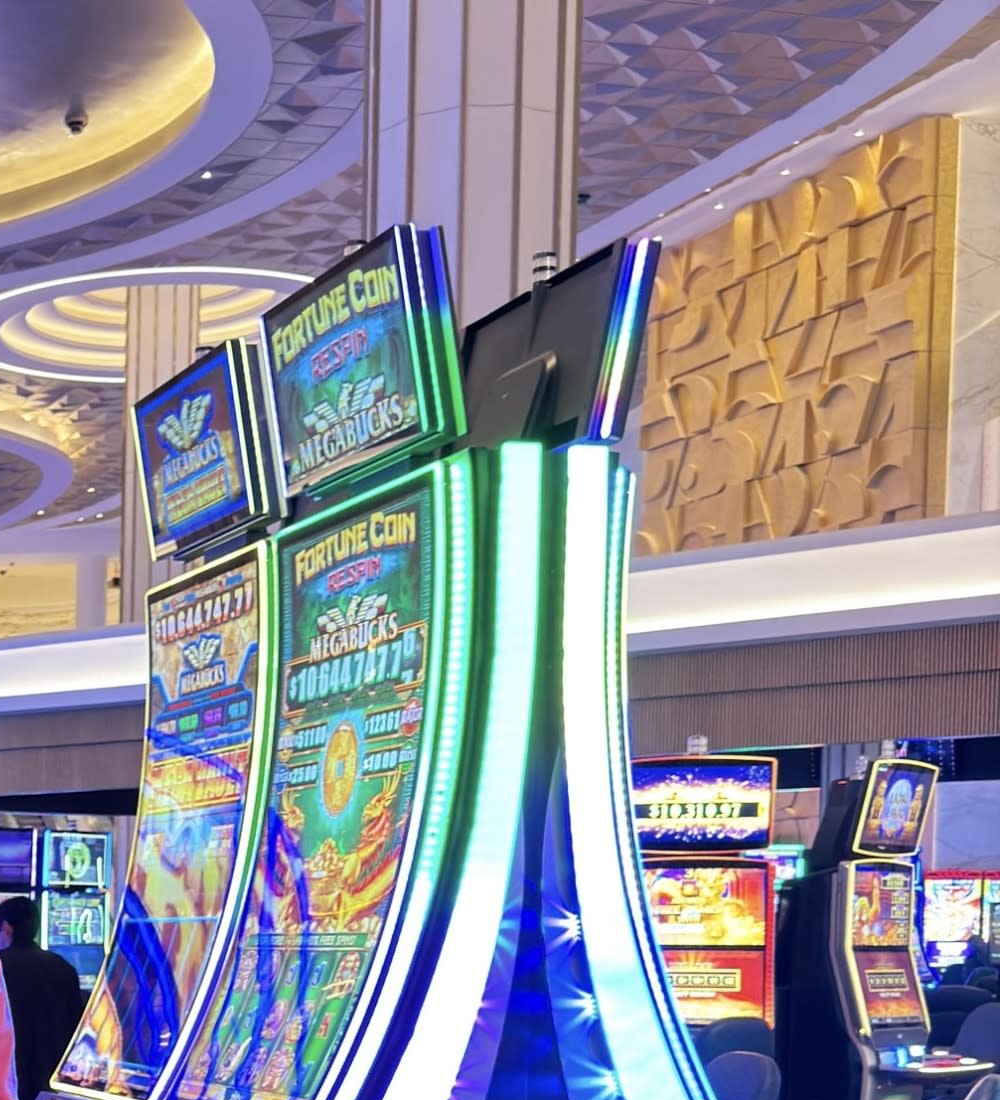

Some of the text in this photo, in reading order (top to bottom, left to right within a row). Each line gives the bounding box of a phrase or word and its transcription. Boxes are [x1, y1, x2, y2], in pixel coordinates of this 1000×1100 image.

[271, 283, 351, 372] FORTUNE
[311, 327, 369, 380] RESPIN
[299, 393, 404, 472] MEGABUCKS
[295, 521, 369, 587] FORTUNE
[327, 554, 382, 593] RESPIN
[309, 613, 398, 663] MEGABUCKS
